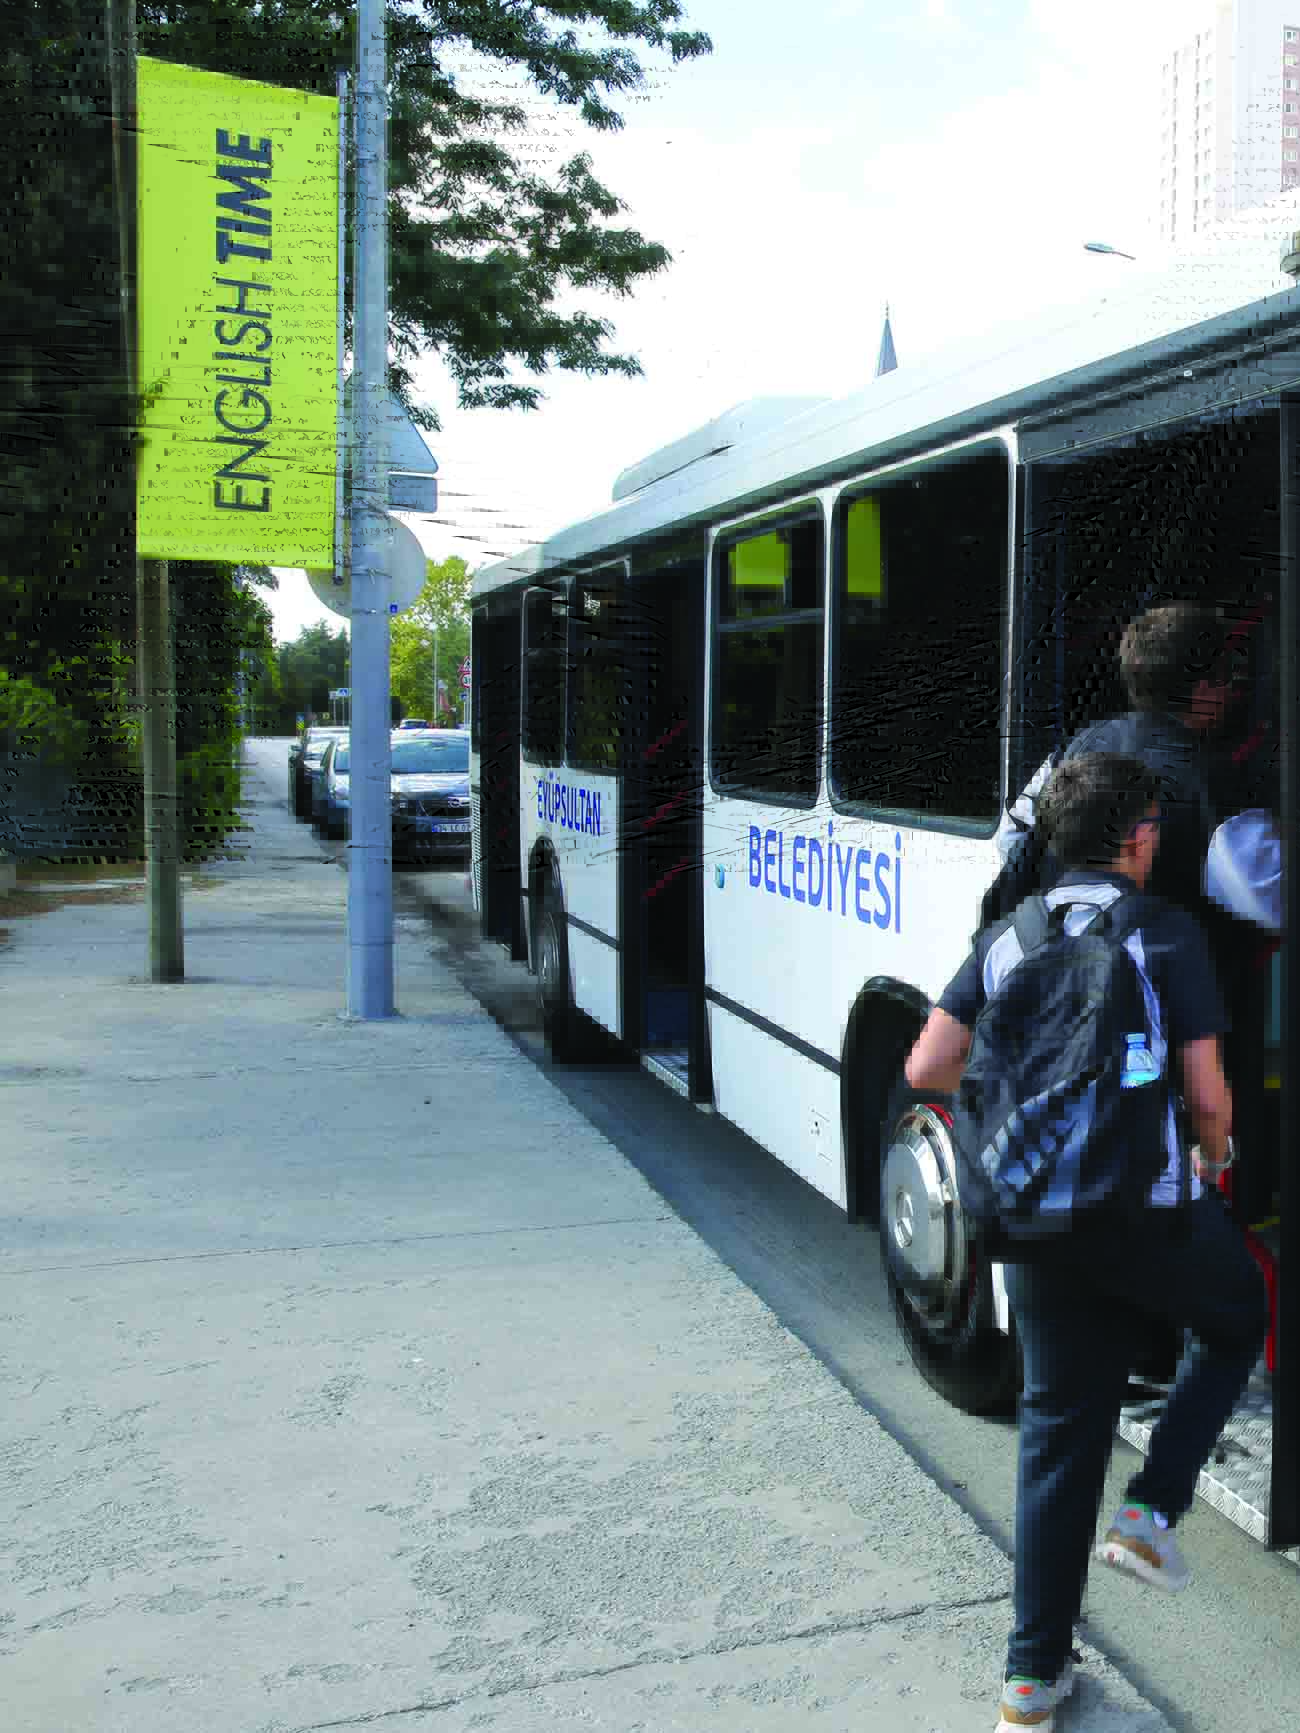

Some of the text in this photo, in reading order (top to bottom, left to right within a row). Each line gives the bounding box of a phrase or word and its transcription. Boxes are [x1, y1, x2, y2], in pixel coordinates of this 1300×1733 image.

[214, 128, 273, 513] ENGLISH TIME
[537, 772, 901, 934] EYÜPSULTAN BELEDİYESİ
